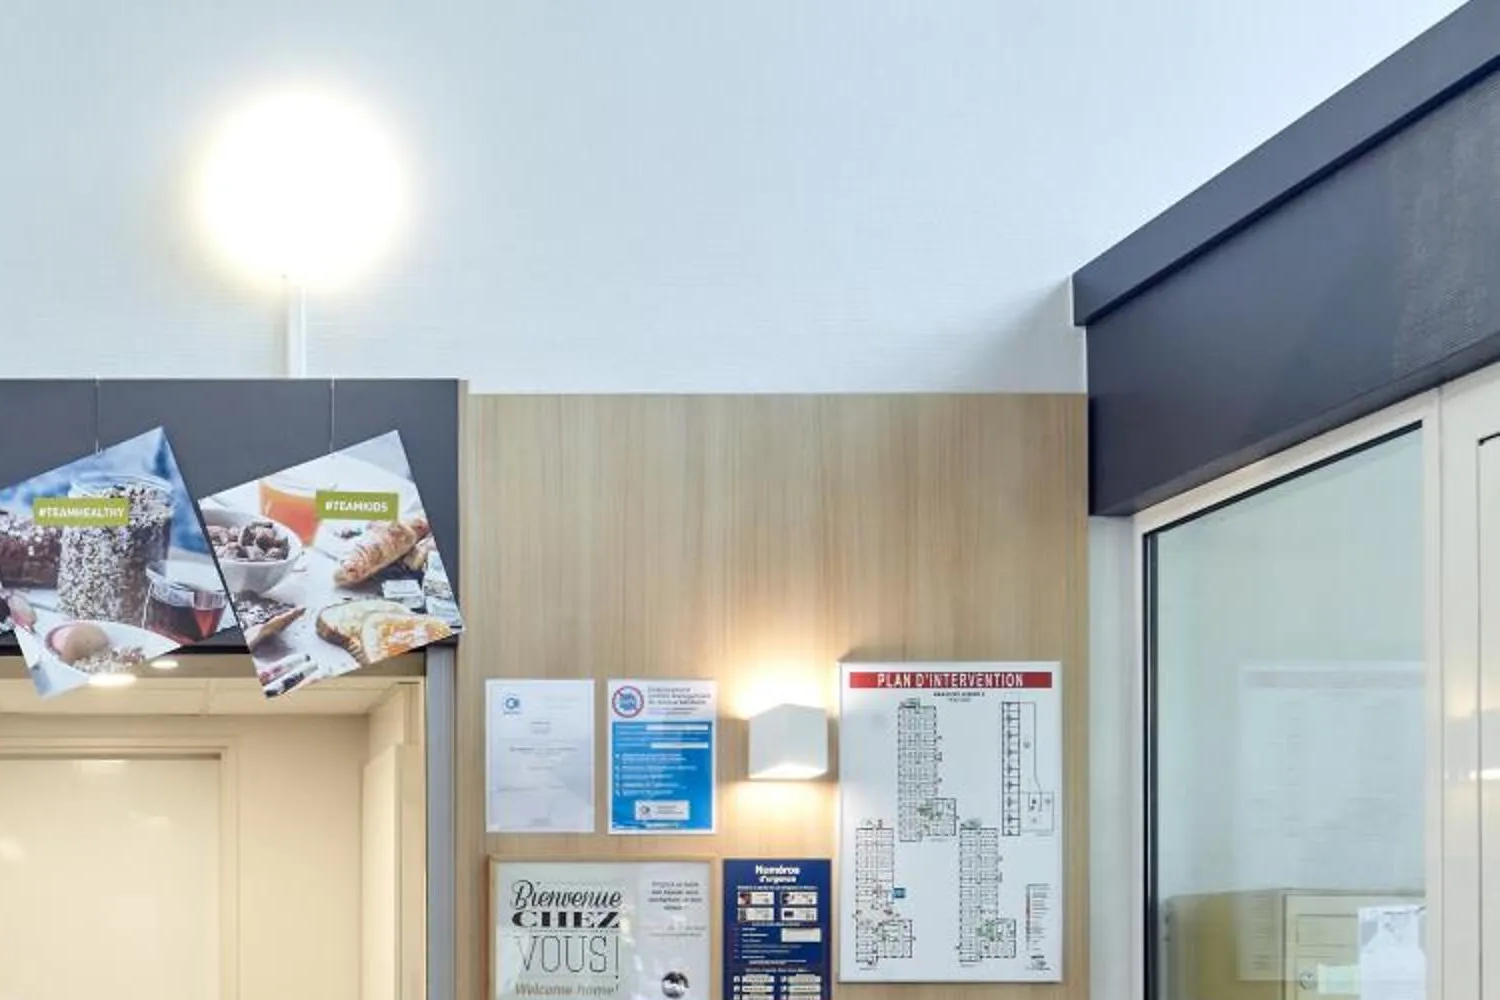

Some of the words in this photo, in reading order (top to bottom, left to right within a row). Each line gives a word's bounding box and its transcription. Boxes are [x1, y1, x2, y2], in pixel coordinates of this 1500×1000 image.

[38, 506, 125, 518] #TEAMHEALTHY
[325, 501, 389, 512] #TEAMKIDS
[877, 672, 911, 687] PLAN
[916, 672, 1024, 688] D'INTERVENTION
[511, 880, 621, 910] Bienvenue
[512, 911, 621, 929] CHEZ
[515, 983, 575, 996] Welcome
